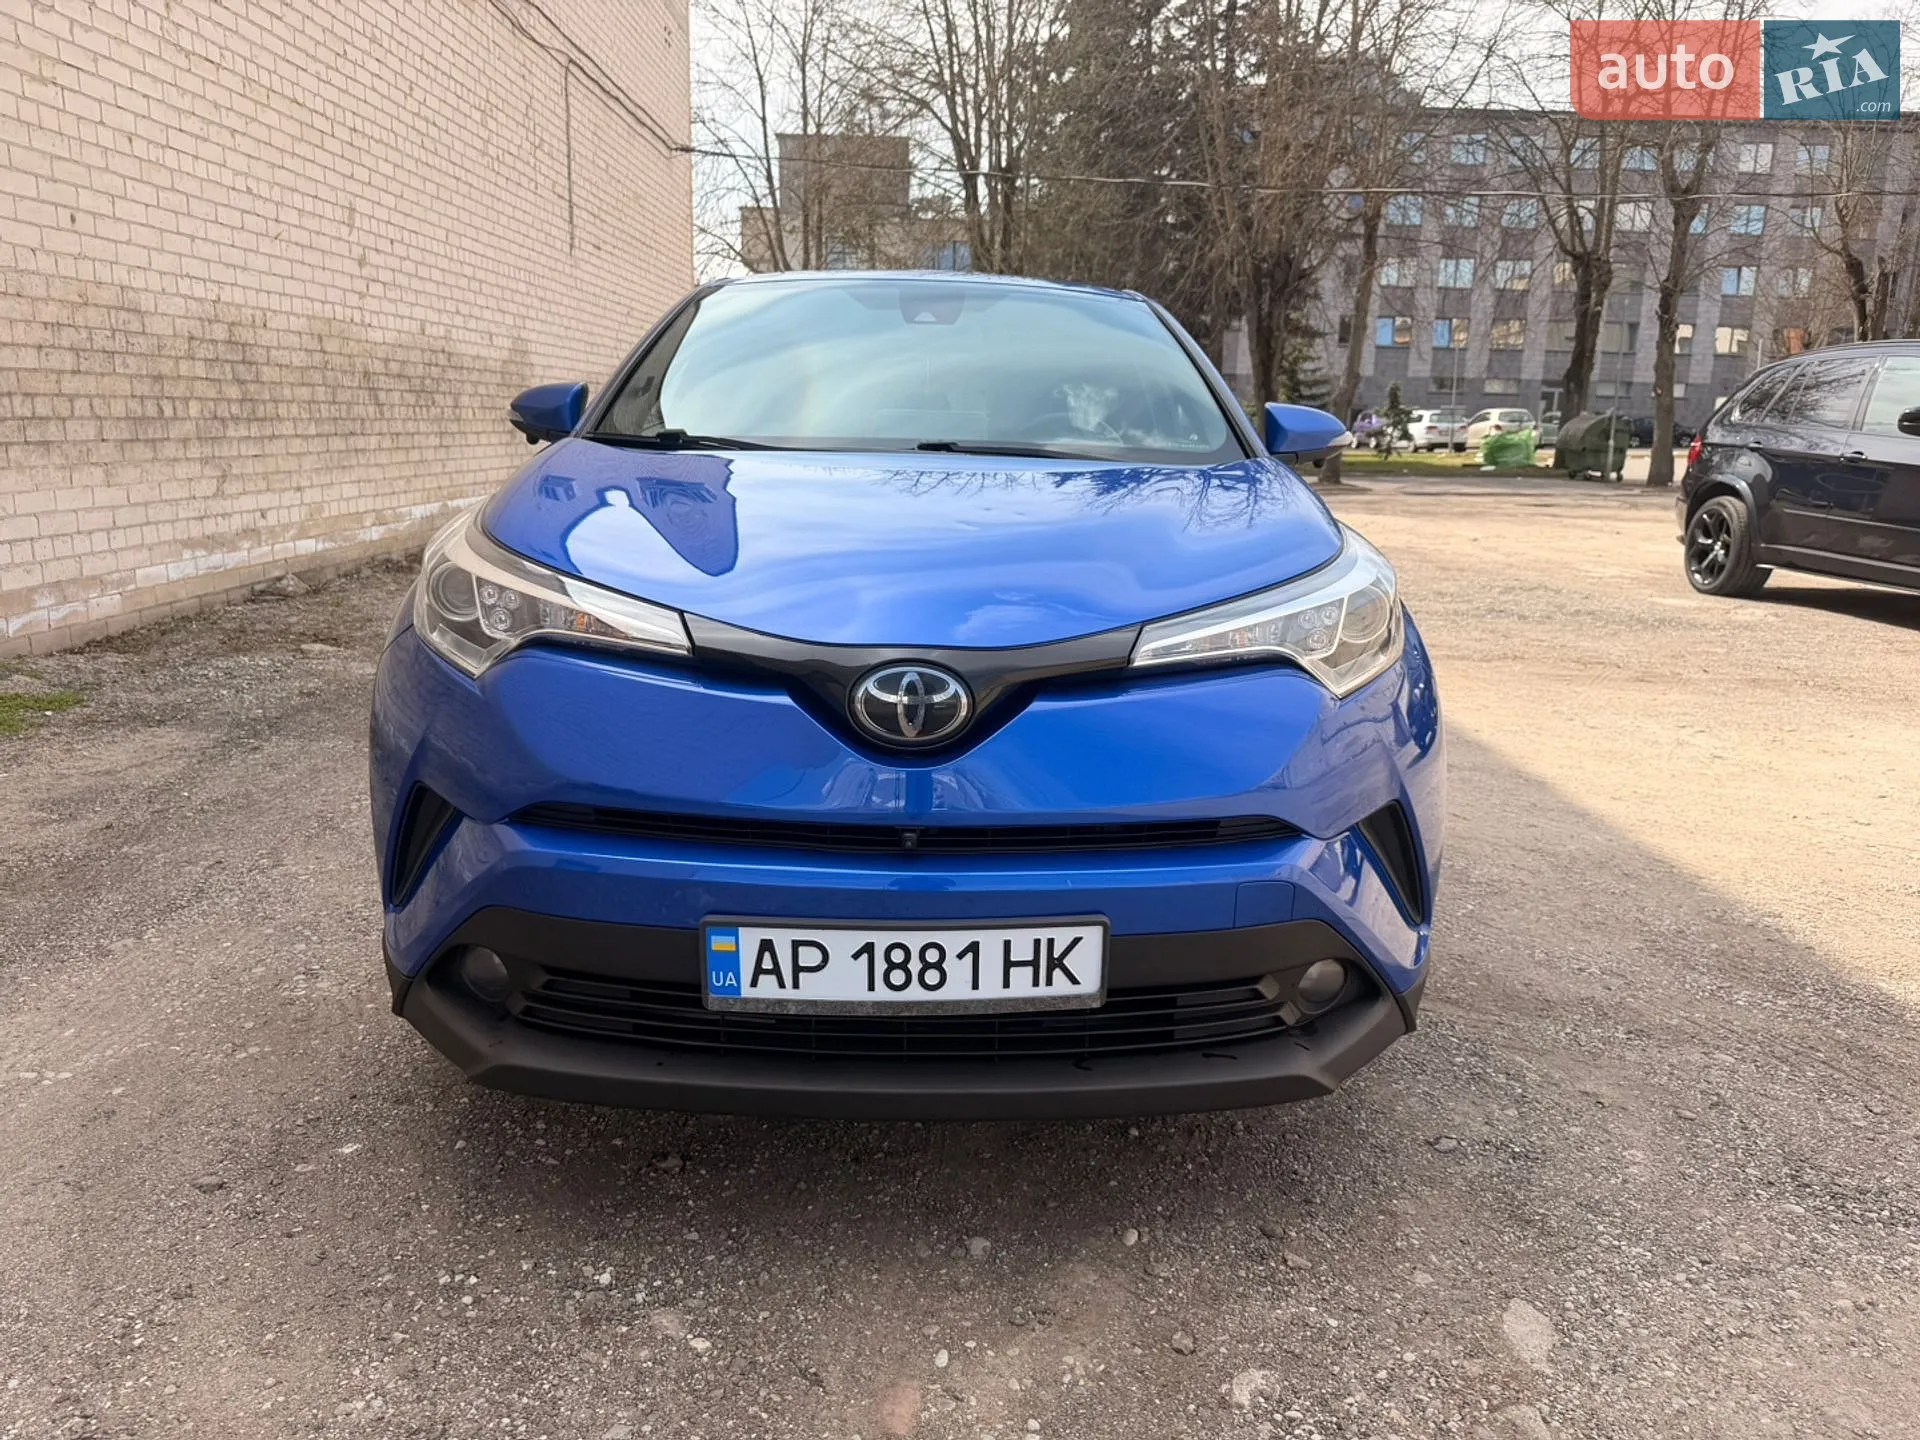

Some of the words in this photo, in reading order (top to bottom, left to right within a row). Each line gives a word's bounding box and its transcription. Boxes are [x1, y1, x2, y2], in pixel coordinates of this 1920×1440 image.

[711, 970, 737, 988] UA
[750, 937, 830, 990] AP
[850, 940, 981, 992] 1881
[1002, 936, 1084, 989] HK
